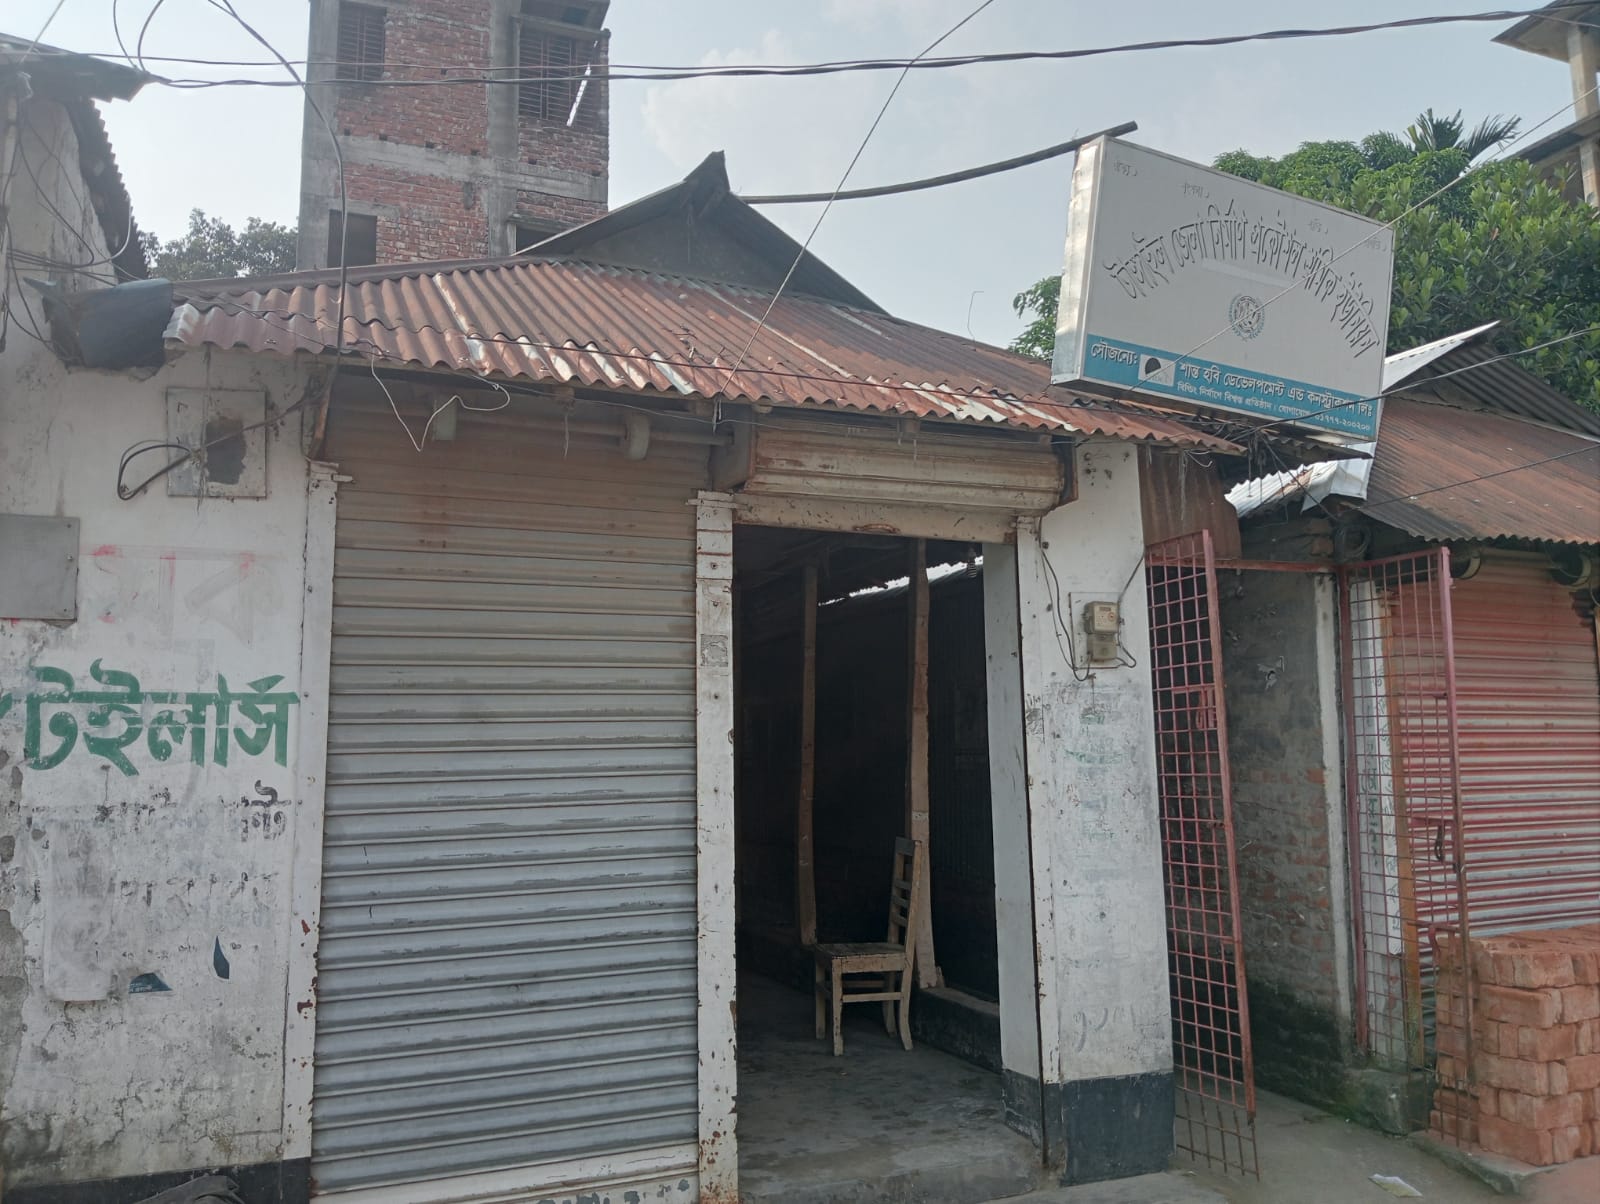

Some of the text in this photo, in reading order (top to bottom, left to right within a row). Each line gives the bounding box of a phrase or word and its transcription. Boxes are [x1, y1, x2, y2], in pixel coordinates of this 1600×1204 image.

[1171, 212, 1208, 268] জেলা
[1207, 198, 1248, 260] নির্মাণ
[1250, 210, 1307, 278] প্রকৌশল
[1303, 246, 1343, 303] শ্রমিক
[1336, 271, 1380, 358] ইউনিয়ন
[1223, 373, 1284, 395] ডেভেলপমেন্ট
[1287, 387, 1304, 401] এন্ড
[0, 658, 301, 777] টইলার্স
